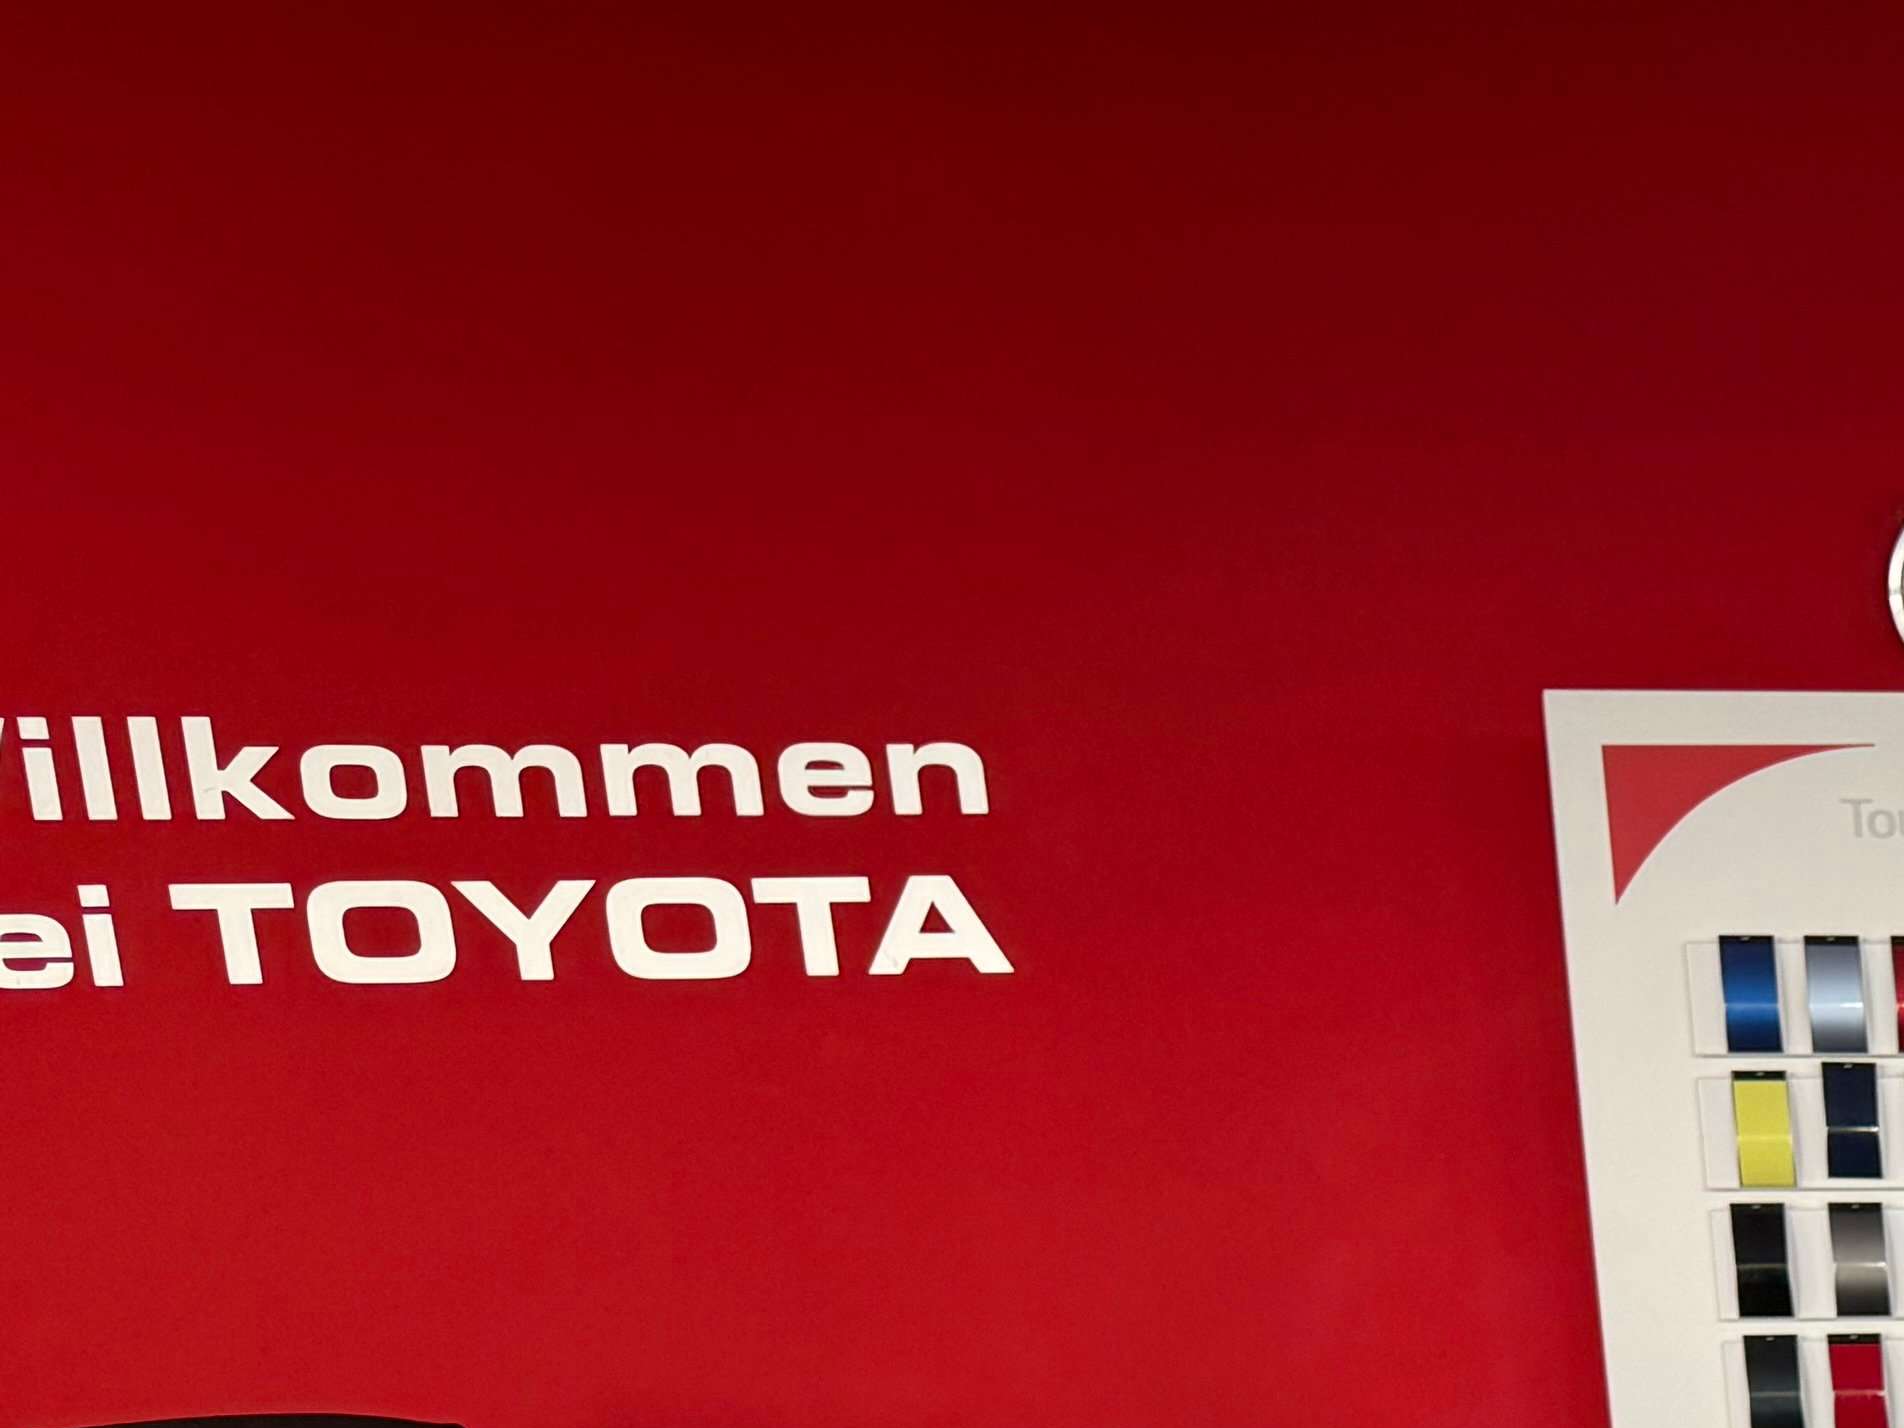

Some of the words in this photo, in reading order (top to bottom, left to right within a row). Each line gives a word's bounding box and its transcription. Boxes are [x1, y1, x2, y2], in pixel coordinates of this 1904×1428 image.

[0, 715, 991, 822] illkommen
[0, 883, 126, 989] ei
[168, 874, 1016, 985] TOYOTA
